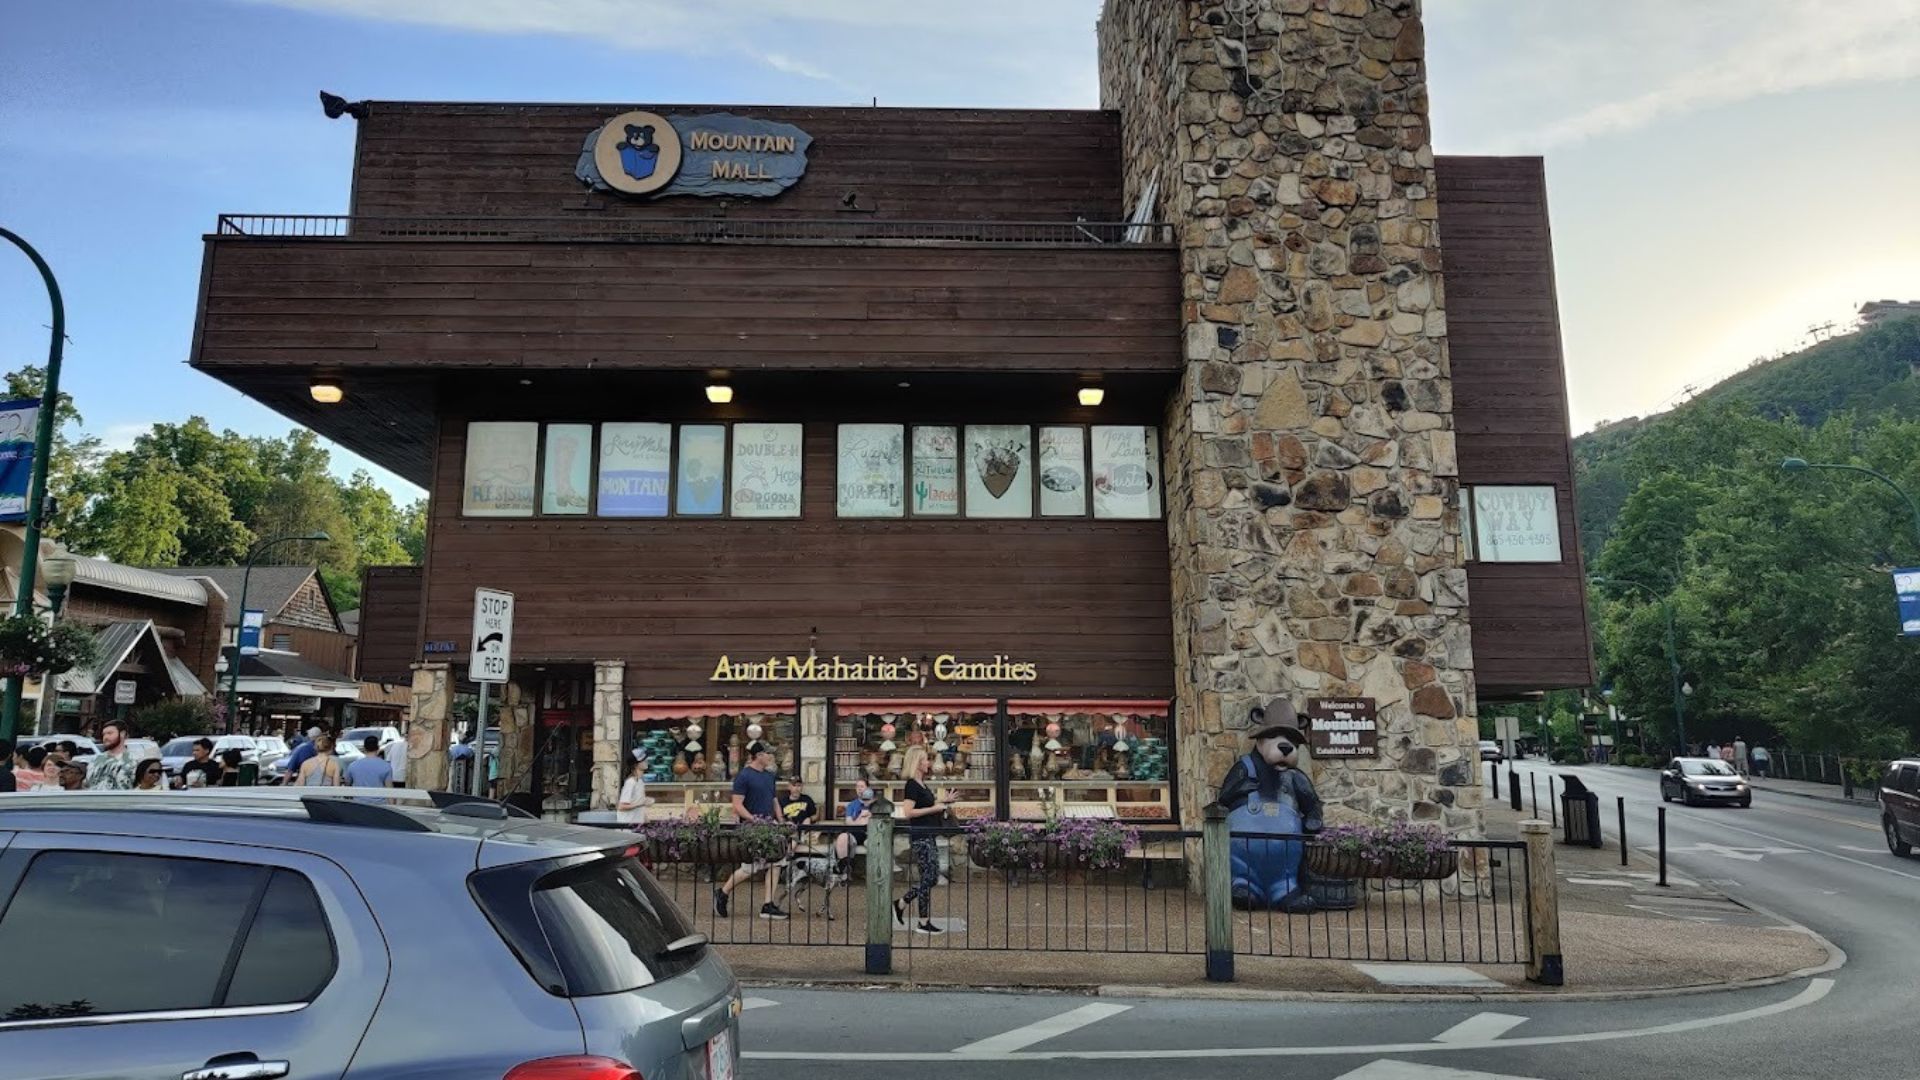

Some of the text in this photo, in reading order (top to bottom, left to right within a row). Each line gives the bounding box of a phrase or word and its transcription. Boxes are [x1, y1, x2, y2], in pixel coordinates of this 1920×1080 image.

[690, 132, 796, 153] MOUNTAIN
[711, 160, 772, 180] MALL
[481, 598, 510, 616] STOP
[485, 618, 502, 630] HERE
[483, 656, 506, 675] RED
[711, 654, 1038, 681] Aunt Mahalia's Candies
[1320, 701, 1366, 710] Welcome to
[1311, 717, 1376, 731] Mountain
[1329, 732, 1359, 745] Mall
